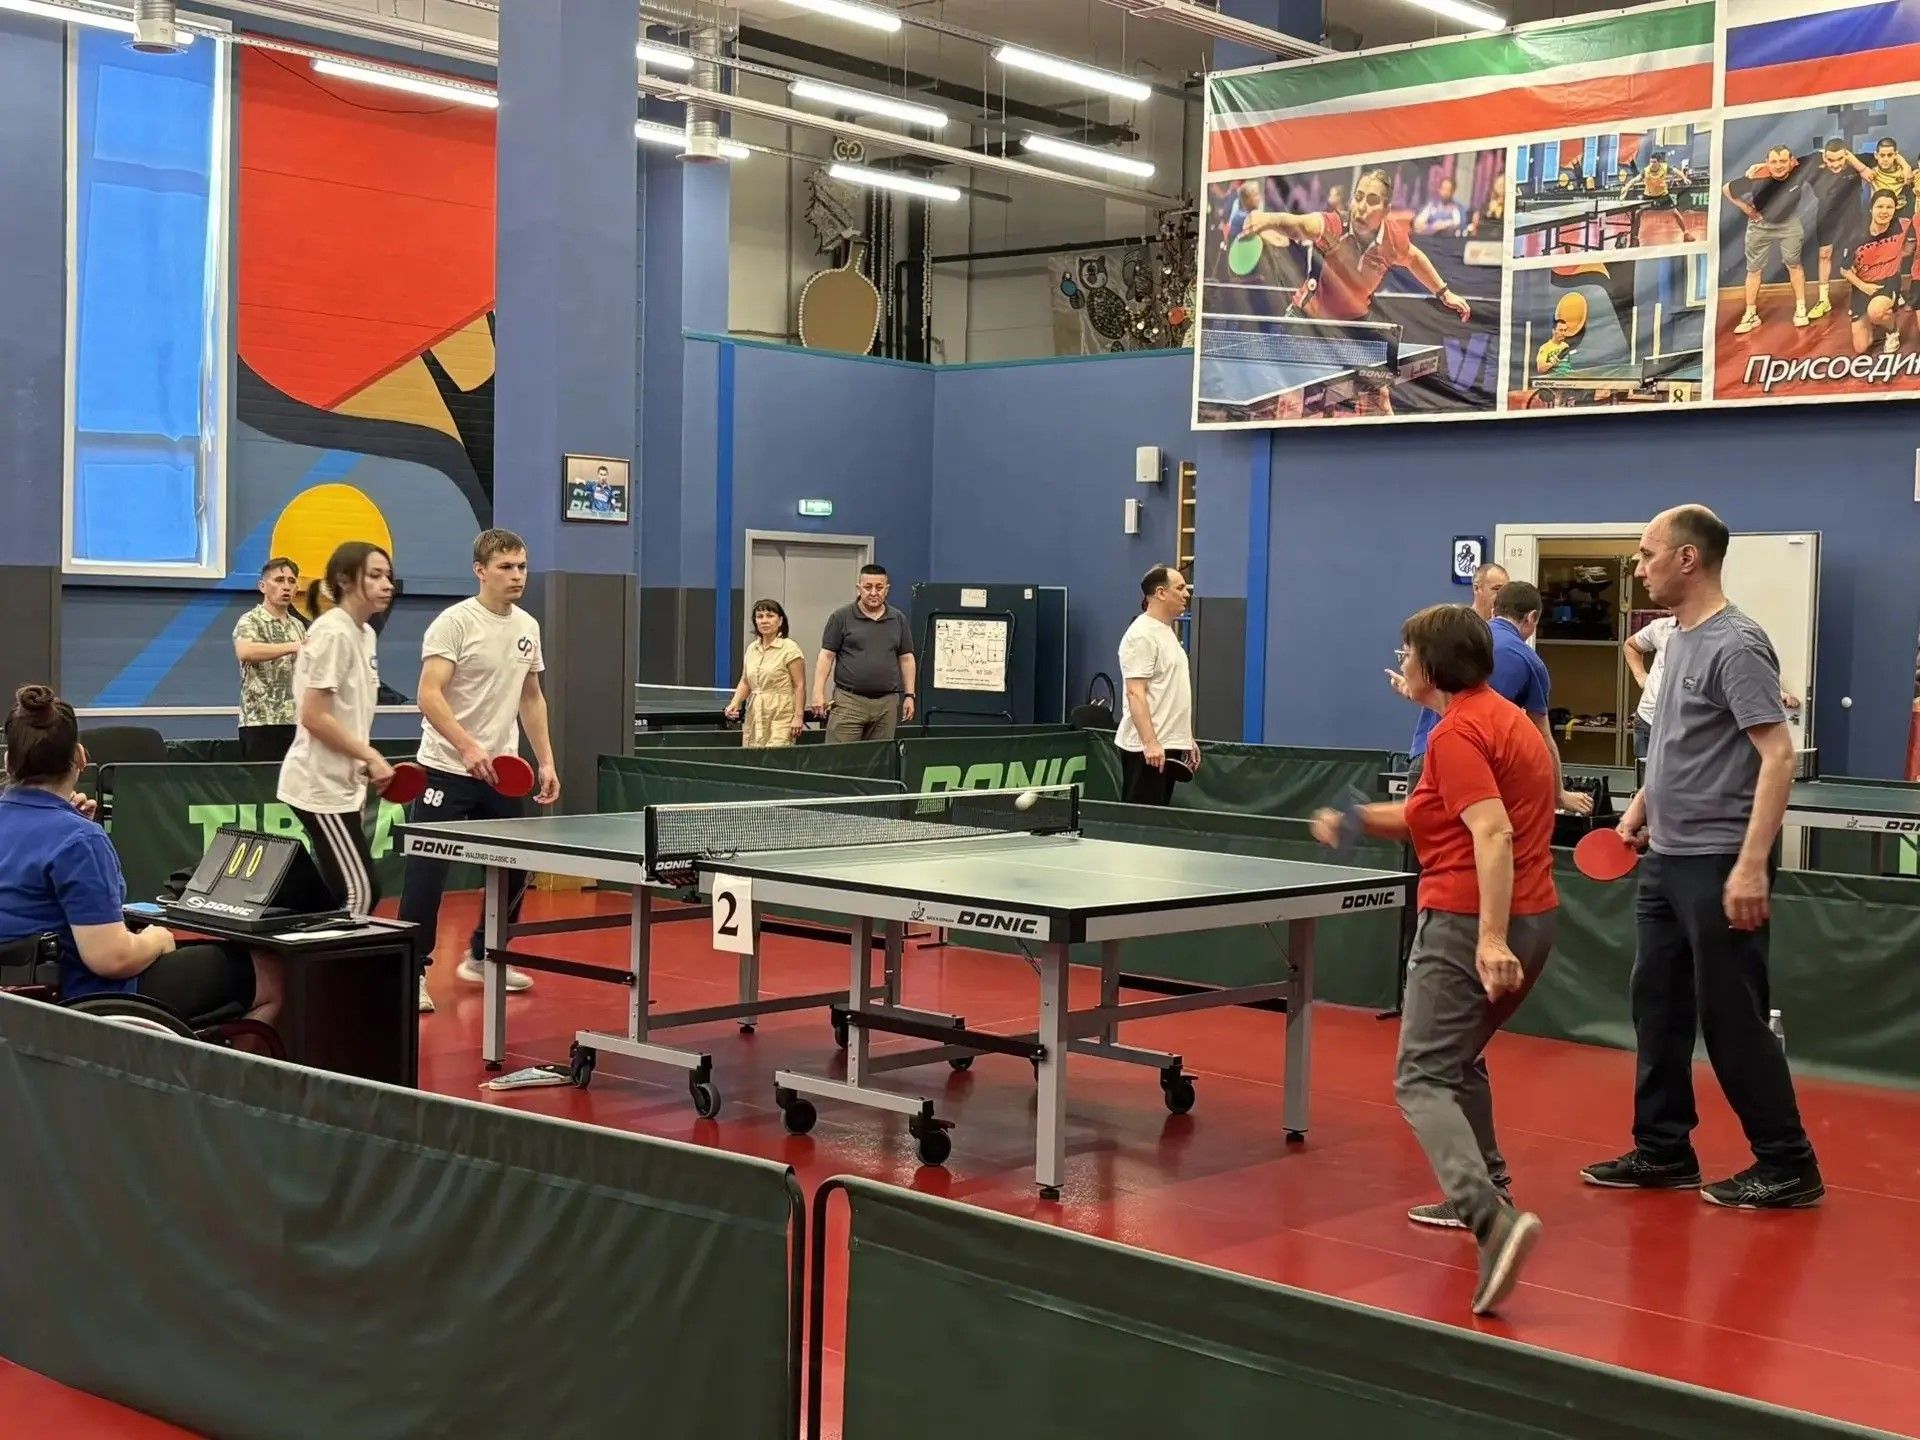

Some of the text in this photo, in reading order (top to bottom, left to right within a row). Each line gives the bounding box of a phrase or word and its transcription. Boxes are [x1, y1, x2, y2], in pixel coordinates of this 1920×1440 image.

[1673, 388, 1684, 403] 8
[917, 755, 1087, 804] DONIC
[423, 787, 445, 807] 98
[412, 839, 465, 857] DONIC
[655, 860, 693, 871] DONIC
[203, 901, 254, 916] DONIC
[1341, 891, 1395, 909] DONIC
[717, 891, 739, 937] 2
[957, 910, 1038, 934] DONIC
